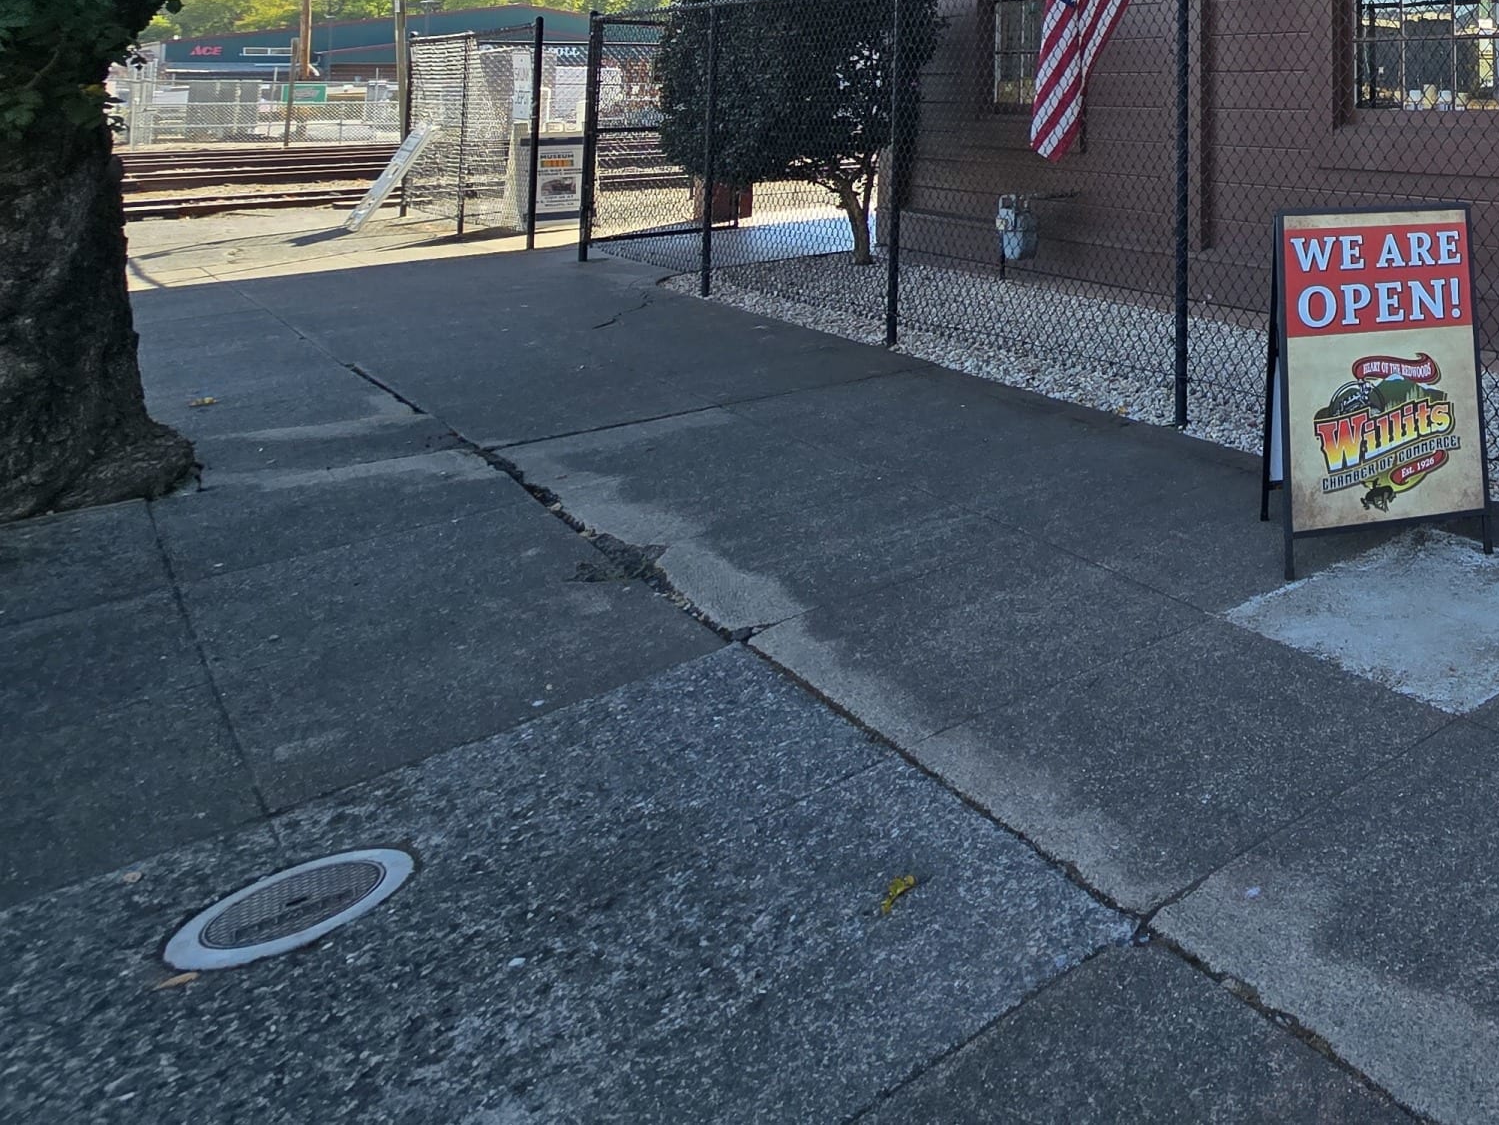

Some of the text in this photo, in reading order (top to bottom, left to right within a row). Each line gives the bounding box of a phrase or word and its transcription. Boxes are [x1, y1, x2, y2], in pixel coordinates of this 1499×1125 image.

[190, 45, 223, 56] ACE
[1290, 230, 1462, 273] WE ARE
[1297, 277, 1462, 329] OPEN!
[1363, 361, 1432, 378] HEART OF THE REDWOODS
[1316, 401, 1451, 472] Willits
[1322, 435, 1458, 492] CHAMBER OF COMMERCE
[1401, 457, 1435, 478] Est. 1926
